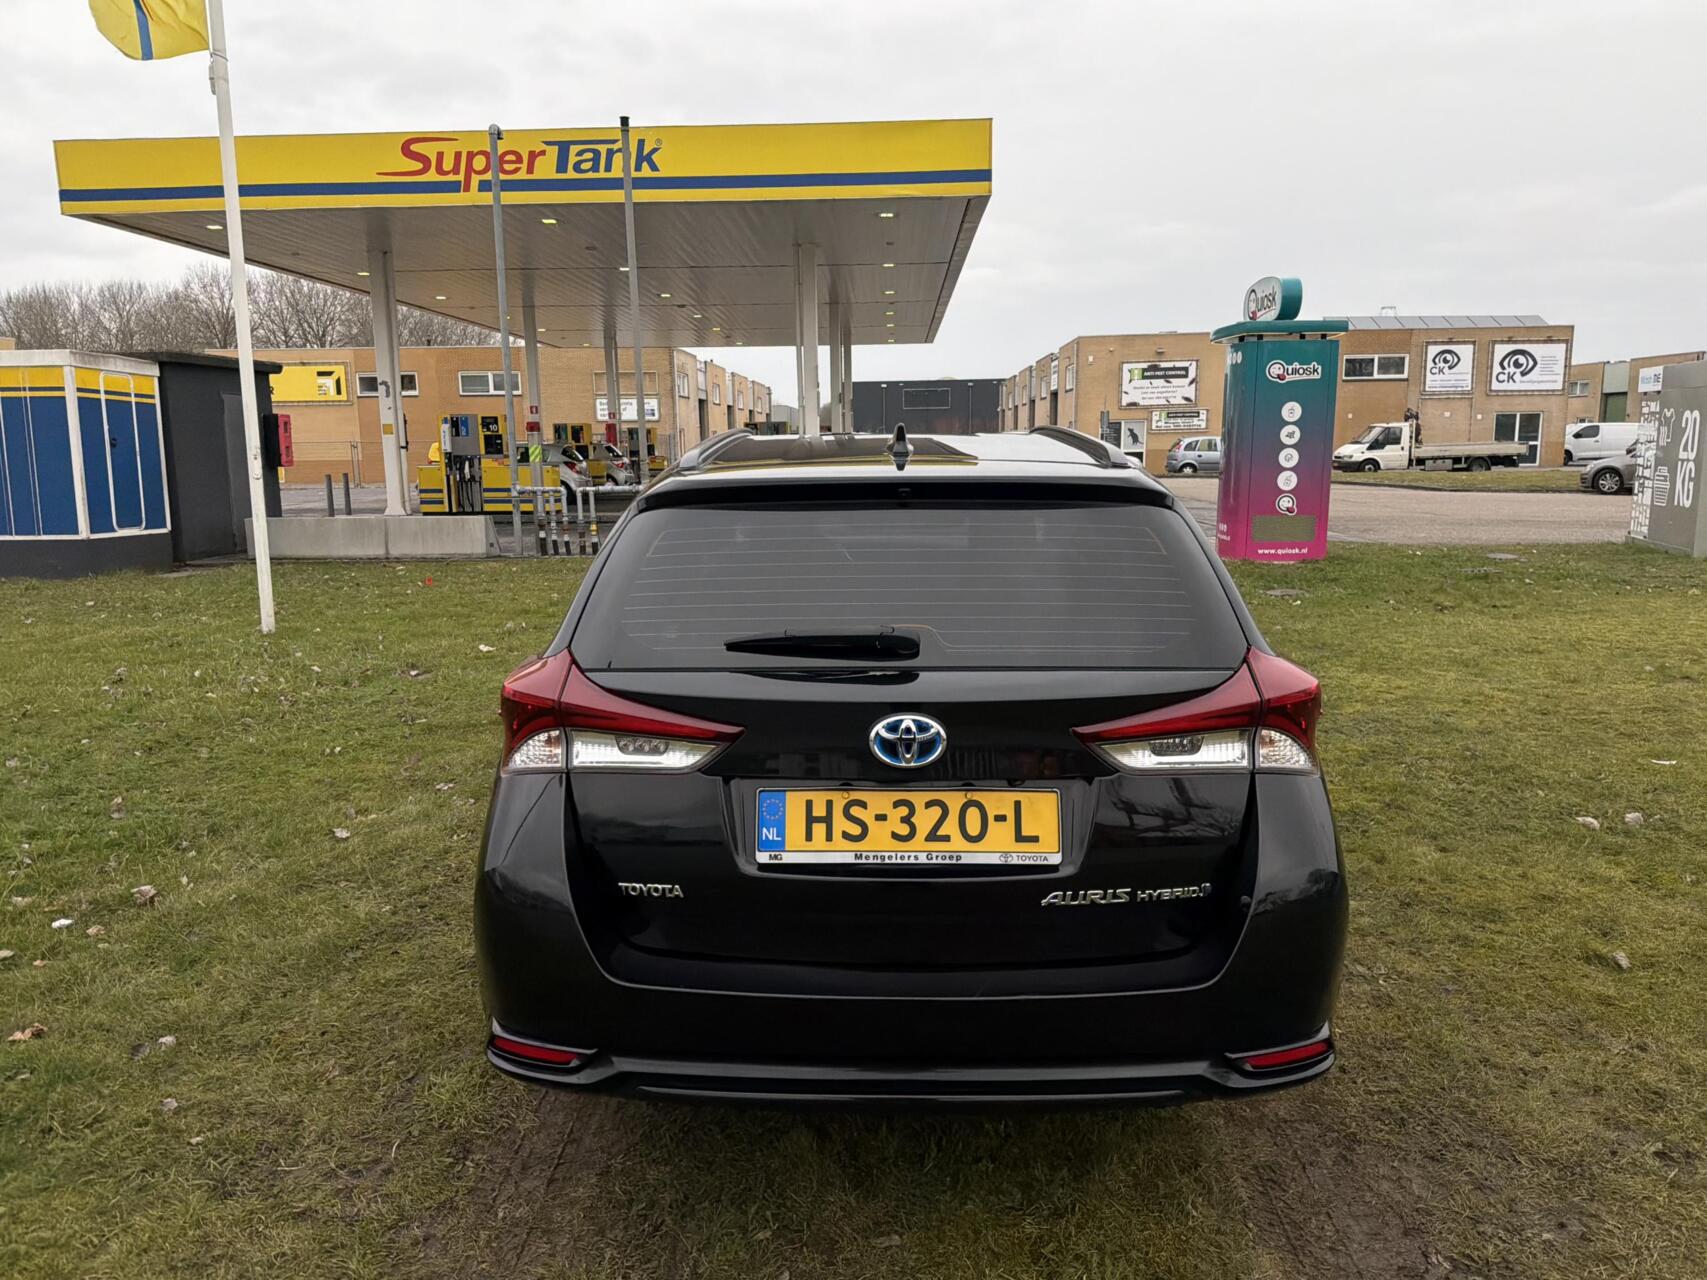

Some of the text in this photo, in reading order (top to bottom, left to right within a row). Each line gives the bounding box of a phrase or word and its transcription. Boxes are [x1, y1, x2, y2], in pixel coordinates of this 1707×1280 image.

[1247, 285, 1278, 320] Quiosk
[1268, 361, 1320, 381] Quiosk
[1429, 366, 1446, 376] CK
[1495, 371, 1517, 384] CK
[1679, 410, 1700, 461] 20
[1674, 461, 1695, 508] KG
[805, 798, 1040, 843] HS-320-L
[762, 827, 782, 841] NL
[768, 853, 783, 861] MG
[854, 853, 919, 863] Mengelers
[926, 853, 962, 862] Groep
[618, 882, 684, 898] TOYOTA
[1041, 886, 1200, 906] AURIS HYBRID
